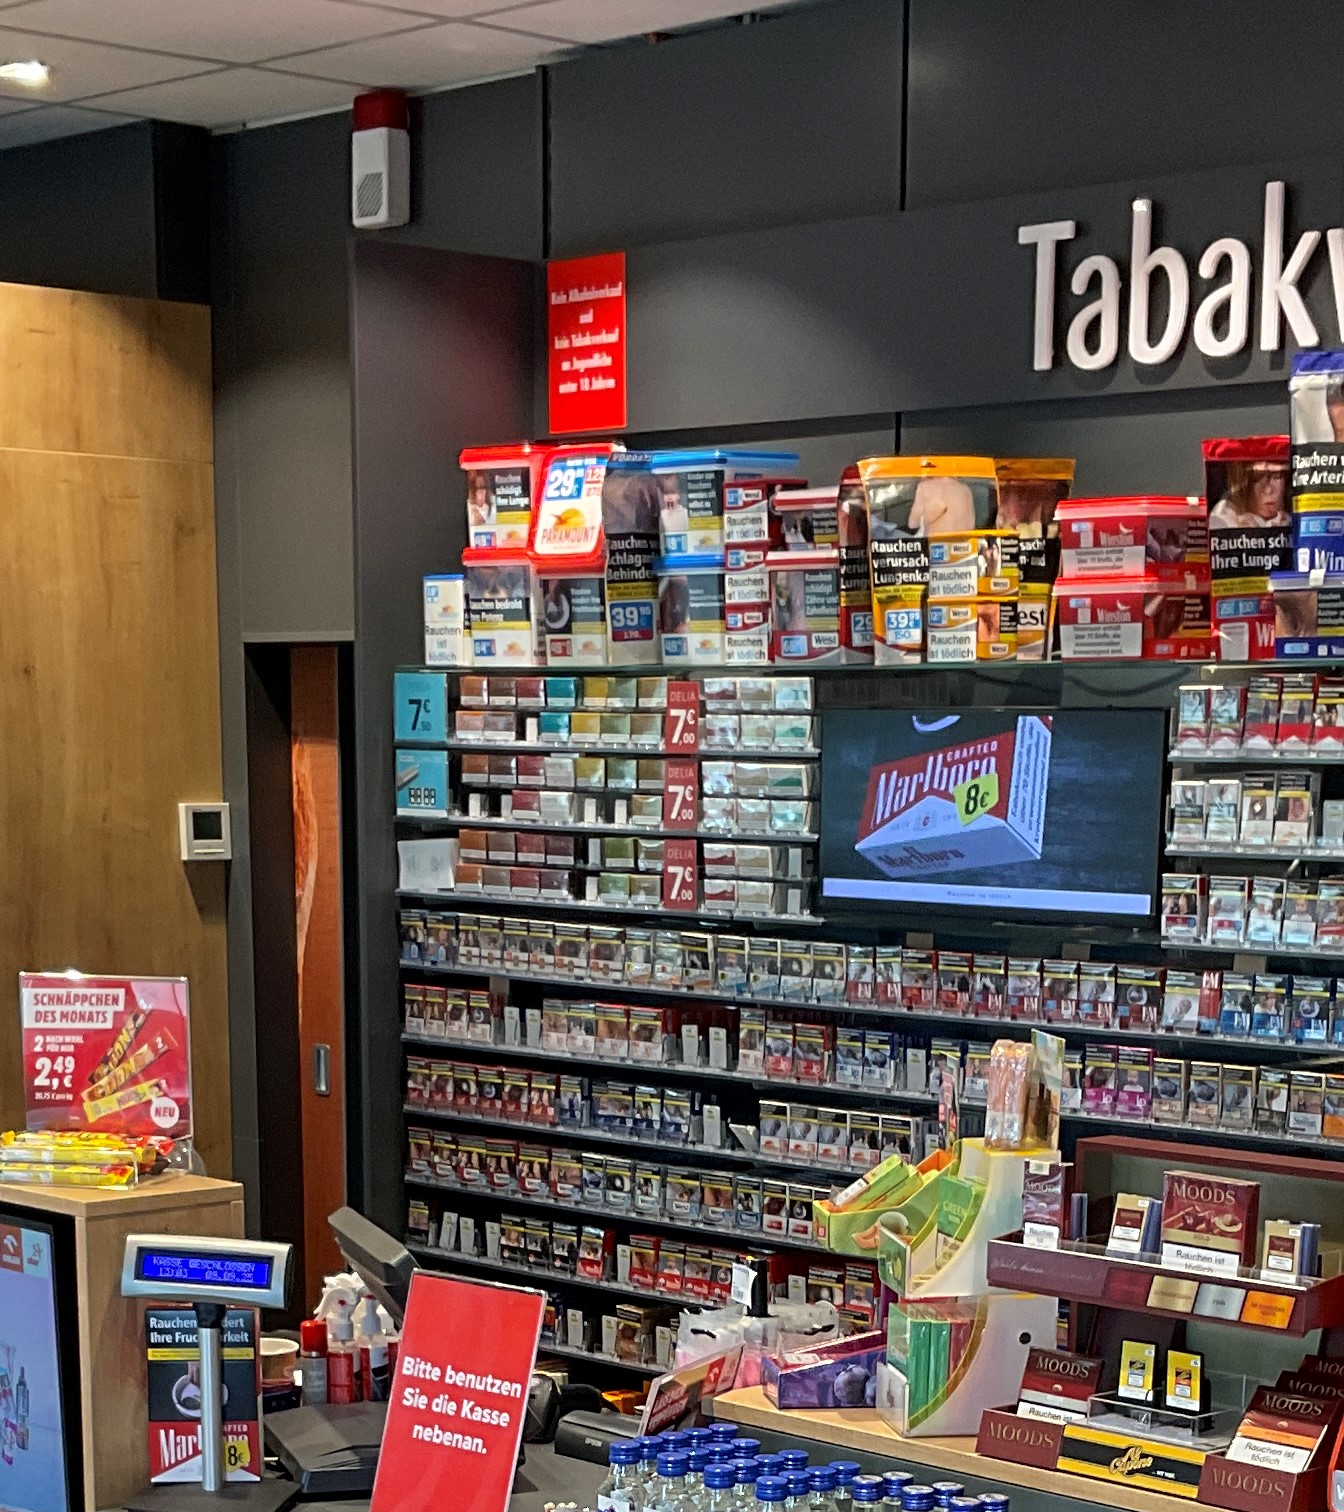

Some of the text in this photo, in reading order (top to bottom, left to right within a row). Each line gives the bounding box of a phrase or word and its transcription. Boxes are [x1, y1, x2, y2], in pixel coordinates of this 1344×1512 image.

[541, 525, 596, 545] PARAMOUNT
[1210, 535, 1264, 551] Rauchen
[871, 540, 921, 553] Rauchen
[1210, 554, 1280, 570] Ihre Lunge
[930, 570, 972, 581] Rauchen
[942, 583, 975, 595] tödlich
[812, 633, 838, 646] West
[930, 634, 971, 645] Rauchen
[669, 691, 696, 702] DELIA
[947, 740, 998, 762] CRAFTED
[668, 767, 695, 778] DELIA
[871, 754, 997, 830] Marlboro
[668, 849, 693, 859] DELIA
[33, 991, 119, 1006] SCHNÄPPCHEN
[35, 1011, 108, 1023] DES MONATS
[34, 1035, 44, 1052] 2
[155, 1107, 175, 1117] NEU
[1173, 1182, 1236, 1205] MOODS
[149, 1316, 197, 1329] Rauchen
[150, 1331, 173, 1343] Ihre
[1036, 1356, 1090, 1379] MOODS
[402, 1356, 522, 1399] Bitte benutzen
[402, 1387, 510, 1427] Sie die Kasse
[1260, 1393, 1325, 1416] MOODS
[412, 1422, 487, 1454] nebenan.
[985, 1421, 1055, 1449] MOODS
[1109, 1456, 1154, 1476] Capone
[1211, 1467, 1286, 1497] MOODS
